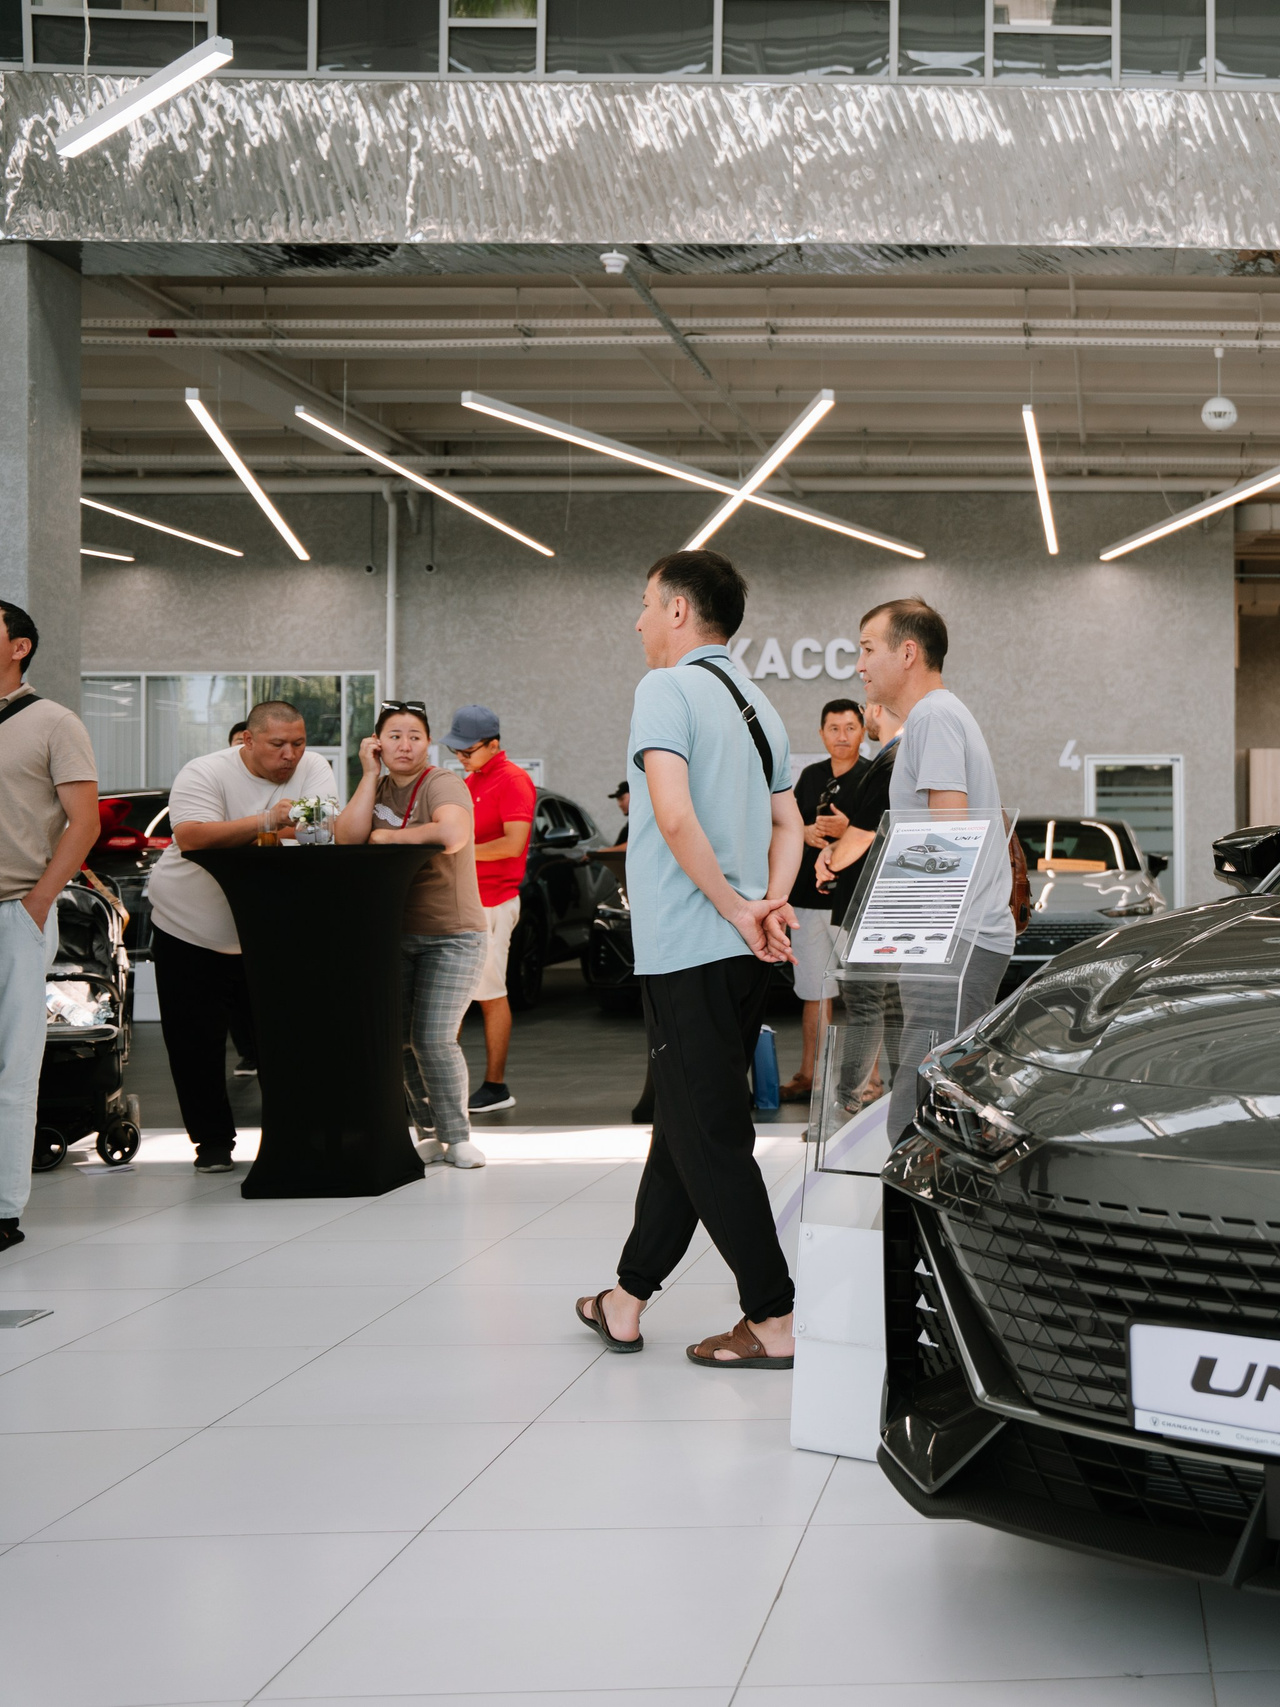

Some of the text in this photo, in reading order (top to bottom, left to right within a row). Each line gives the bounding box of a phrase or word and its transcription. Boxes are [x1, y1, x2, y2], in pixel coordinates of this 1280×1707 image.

[728, 637, 865, 680] КАСС
[1058, 739, 1081, 771] 4
[1161, 1420, 1221, 1437] CHANGAN AUTO
[1235, 1432, 1269, 1446] Changan
